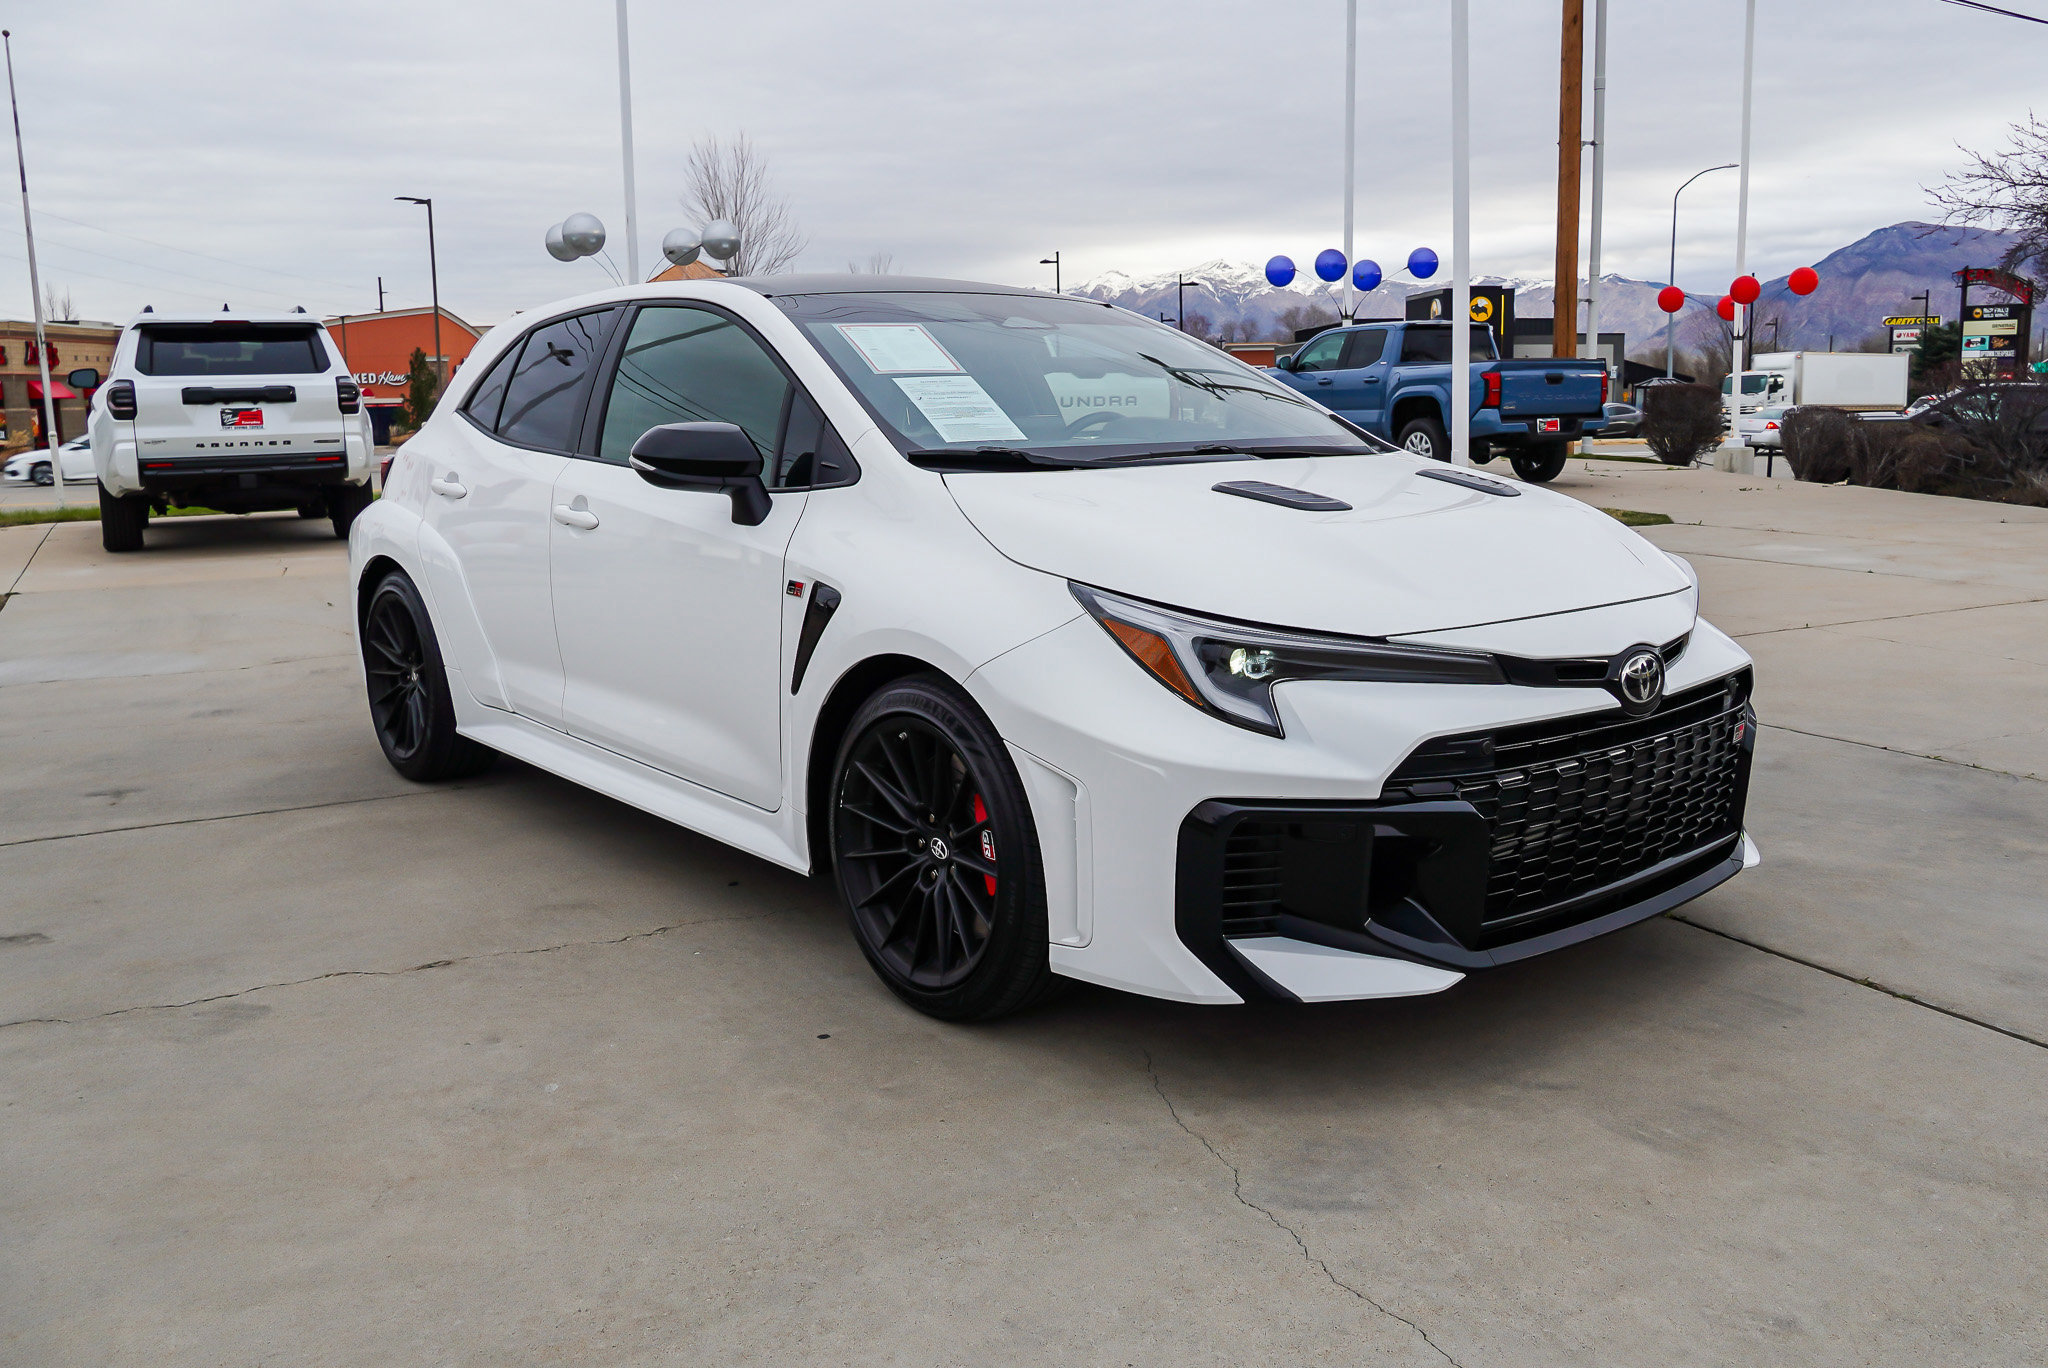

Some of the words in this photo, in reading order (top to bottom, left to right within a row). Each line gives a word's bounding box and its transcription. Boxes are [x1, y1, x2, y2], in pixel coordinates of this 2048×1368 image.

[353, 373, 377, 384] KED
[378, 371, 408, 386] Ham
[1060, 396, 1138, 408] UNDRA
[196, 440, 292, 448] 4RUNNER
